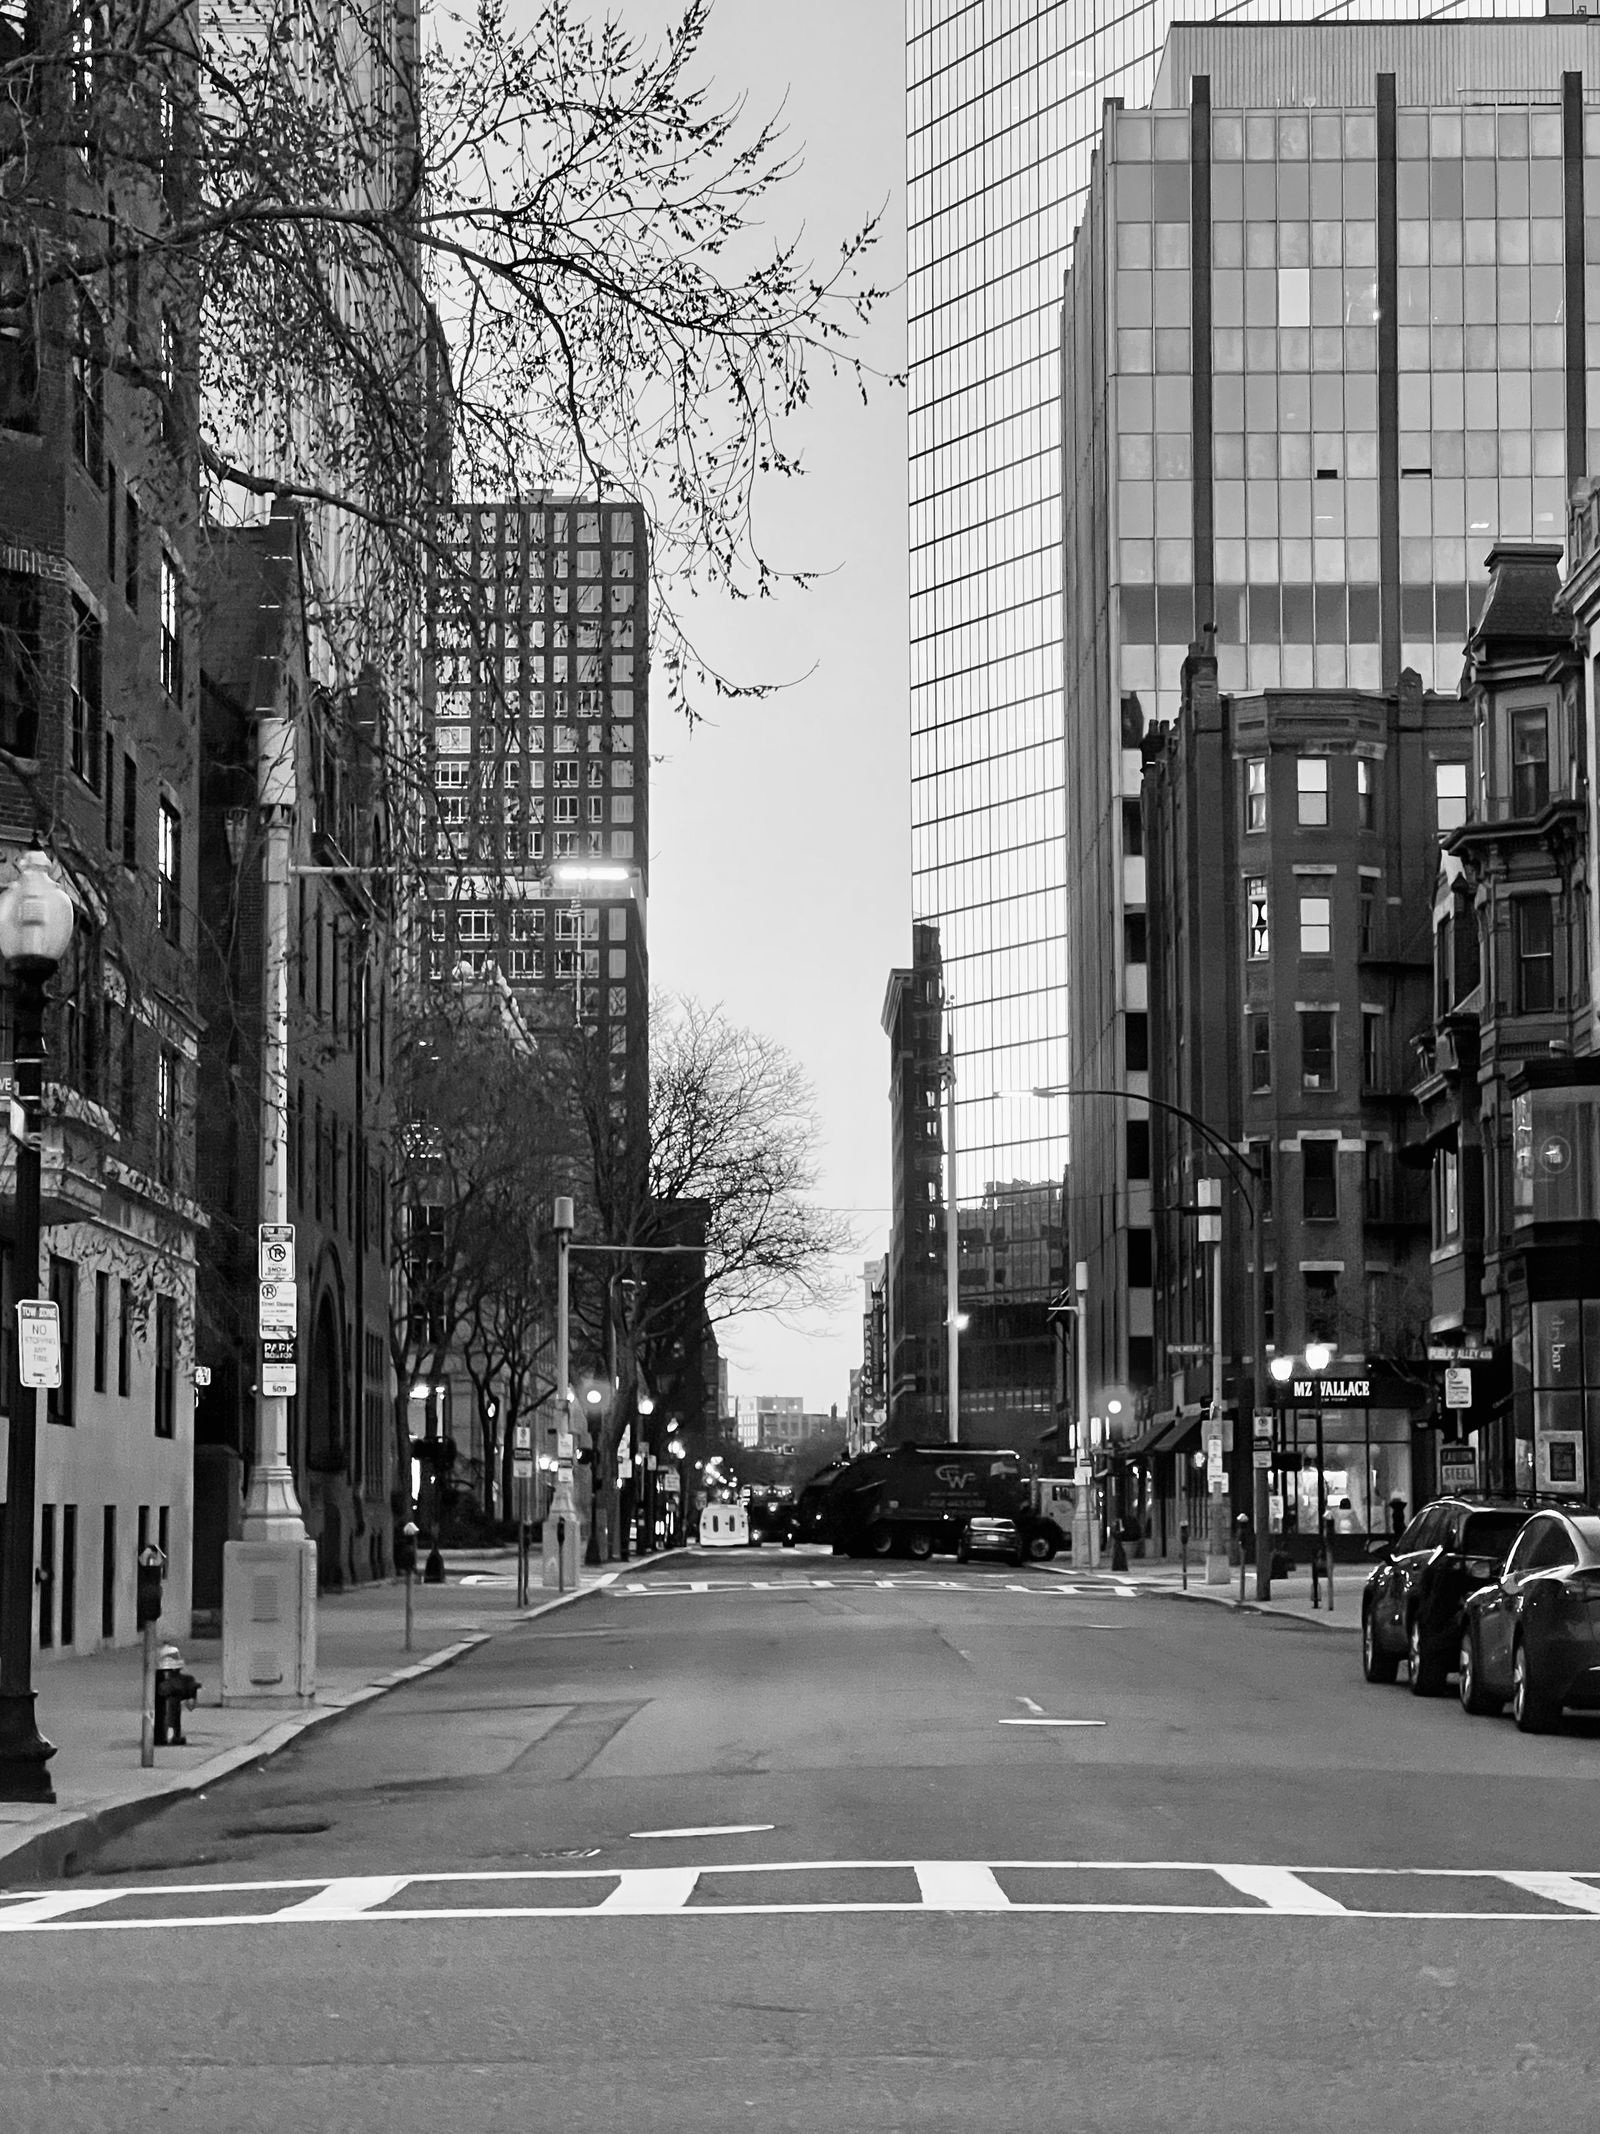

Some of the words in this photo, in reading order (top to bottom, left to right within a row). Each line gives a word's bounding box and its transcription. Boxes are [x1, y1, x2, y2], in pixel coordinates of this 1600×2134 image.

[32, 1324, 48, 1336] NO
[264, 1343, 295, 1352] PARK
[1429, 1348, 1455, 1360] PUBLIC
[1457, 1348, 1479, 1360] ALLEY
[865, 1331, 873, 1395] PARKING
[1294, 1381, 1312, 1397] MZ
[1444, 1467, 1474, 1481] STEEL
